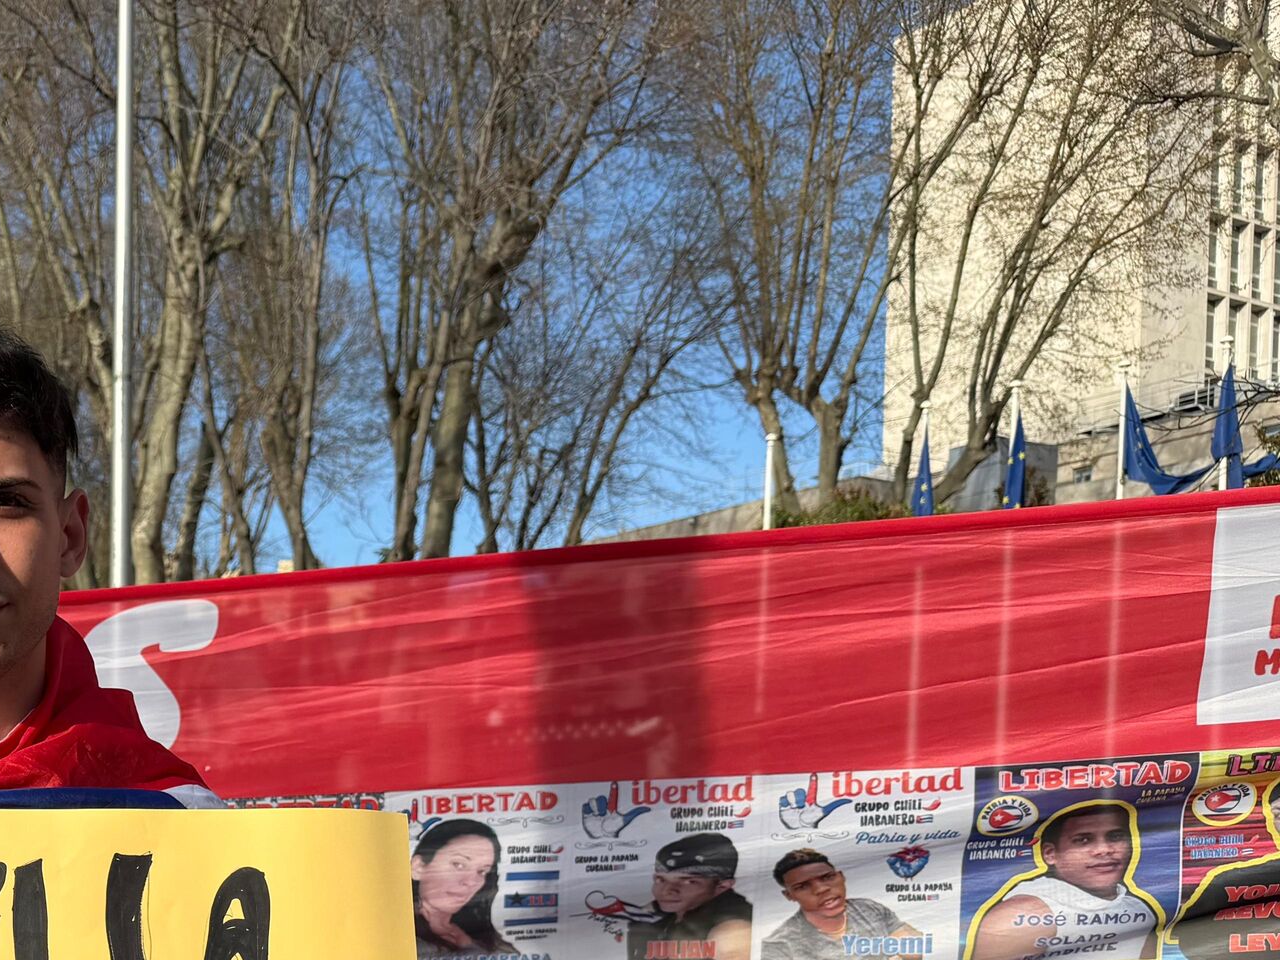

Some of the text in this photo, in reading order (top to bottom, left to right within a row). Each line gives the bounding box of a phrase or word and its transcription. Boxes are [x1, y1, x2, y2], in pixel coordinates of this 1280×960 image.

[998, 760, 1192, 793] LIBERTAD
[854, 802, 889, 813] GRUPO
[860, 814, 915, 827] HABANERO
[855, 829, 961, 845] Patria vida
[886, 883, 953, 893] GRUPO PAPAYA
[897, 894, 927, 902] CUBANA
[842, 934, 933, 956] Yeremi
